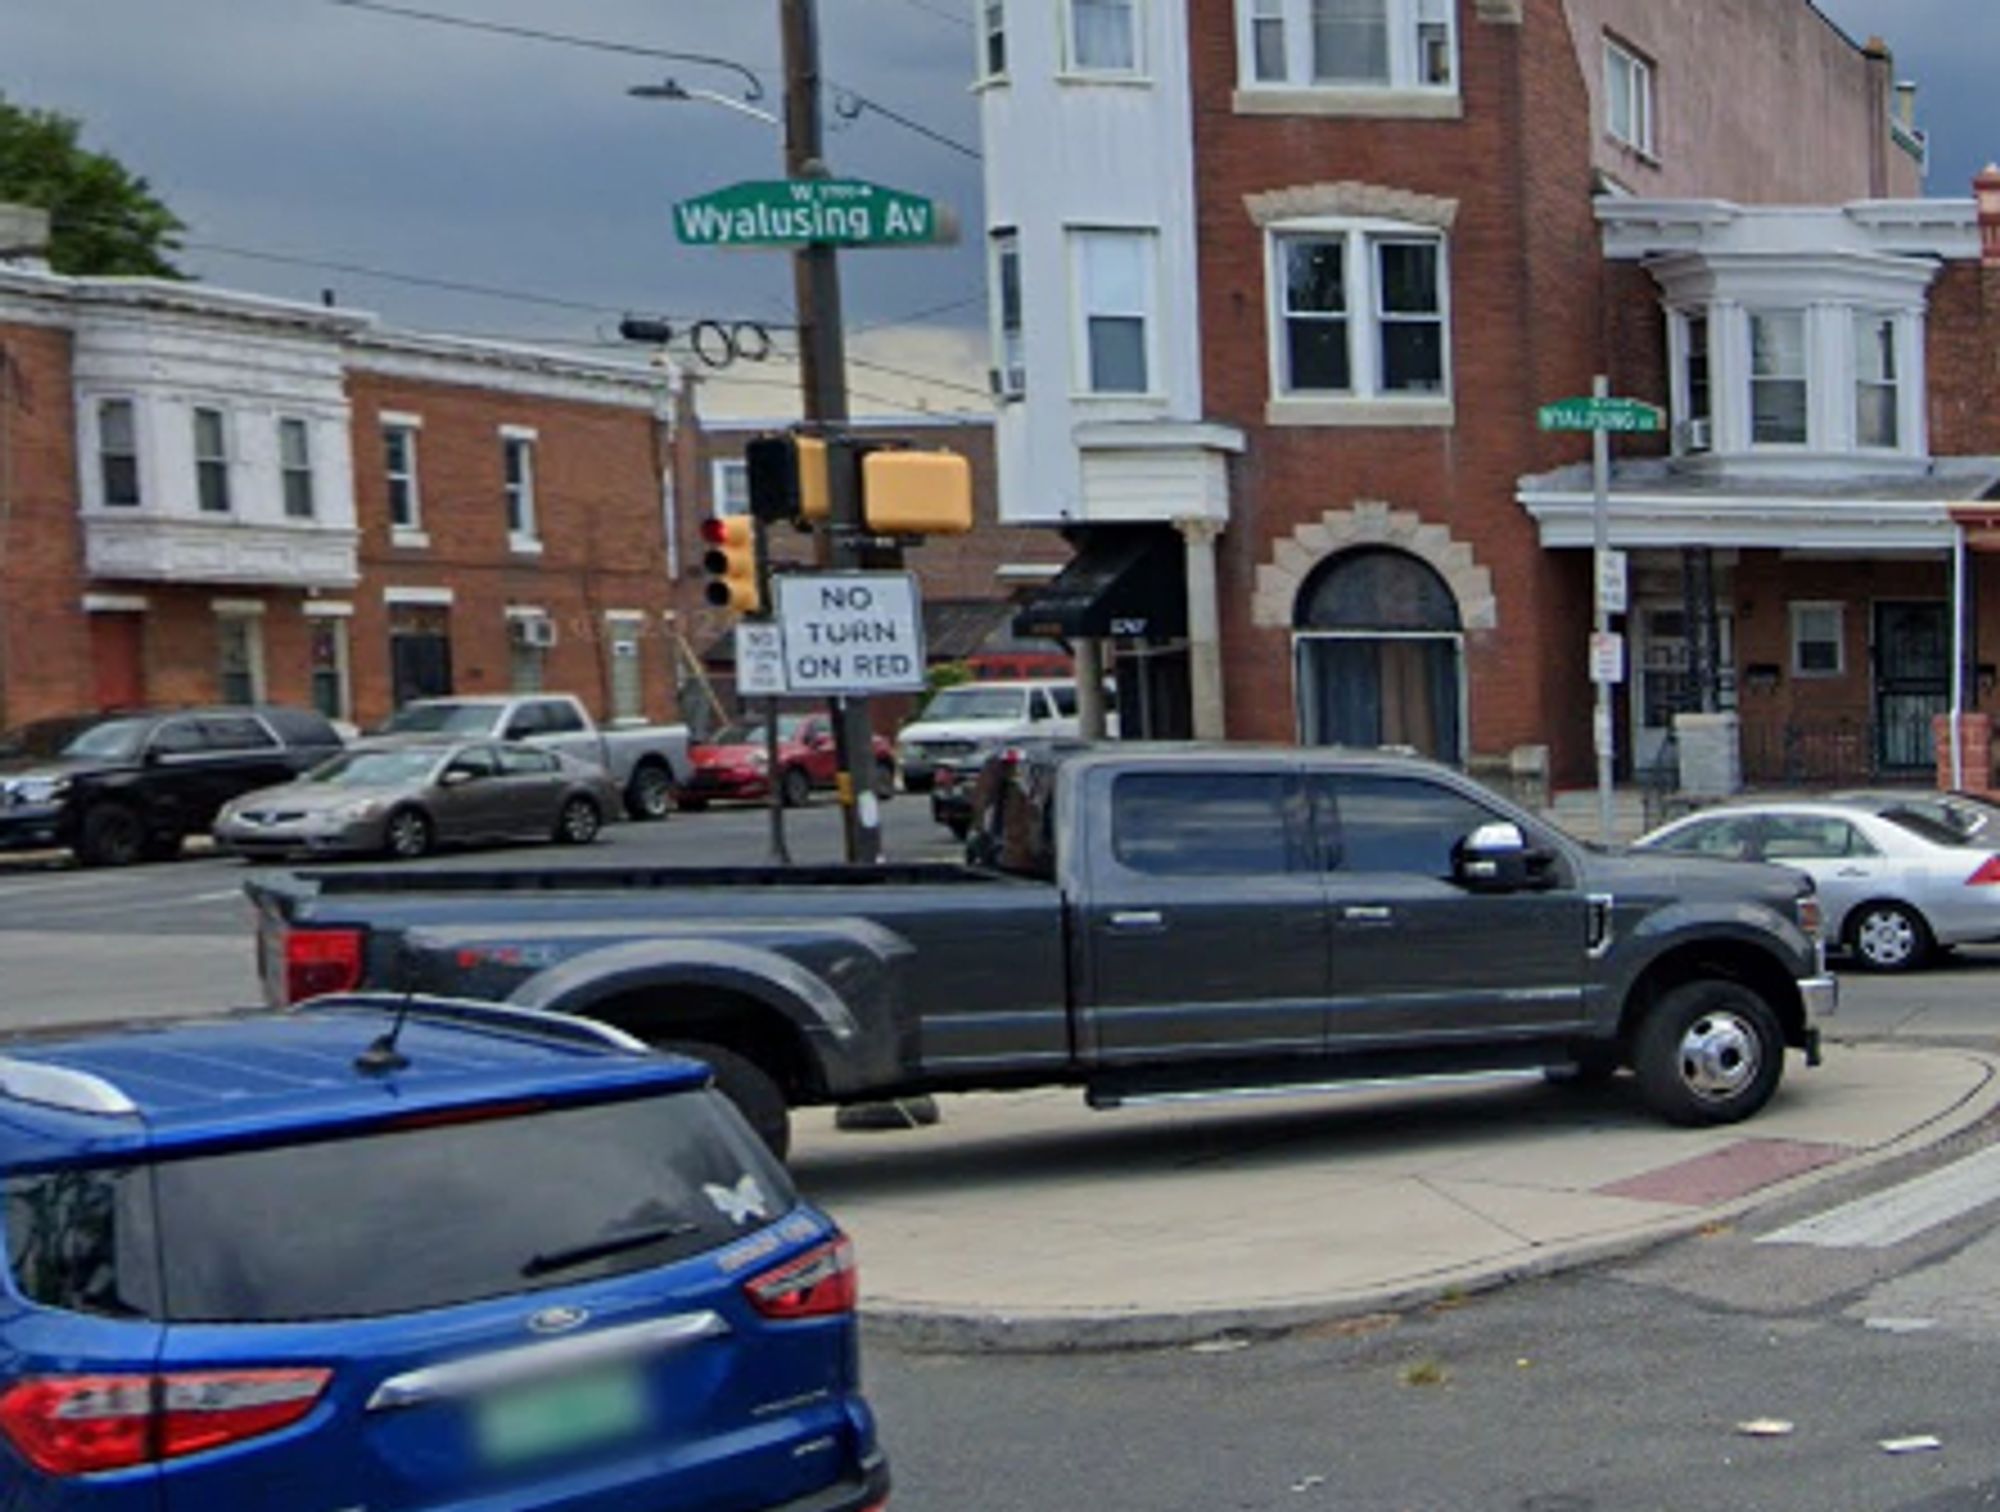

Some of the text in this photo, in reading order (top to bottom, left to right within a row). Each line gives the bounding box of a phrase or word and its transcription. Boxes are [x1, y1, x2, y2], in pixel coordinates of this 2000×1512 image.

[789, 184, 813, 201] W
[680, 201, 927, 241] Wyalusing Av
[820, 586, 873, 611] NO
[806, 620, 897, 645] TURN
[798, 654, 911, 680] ON RED
